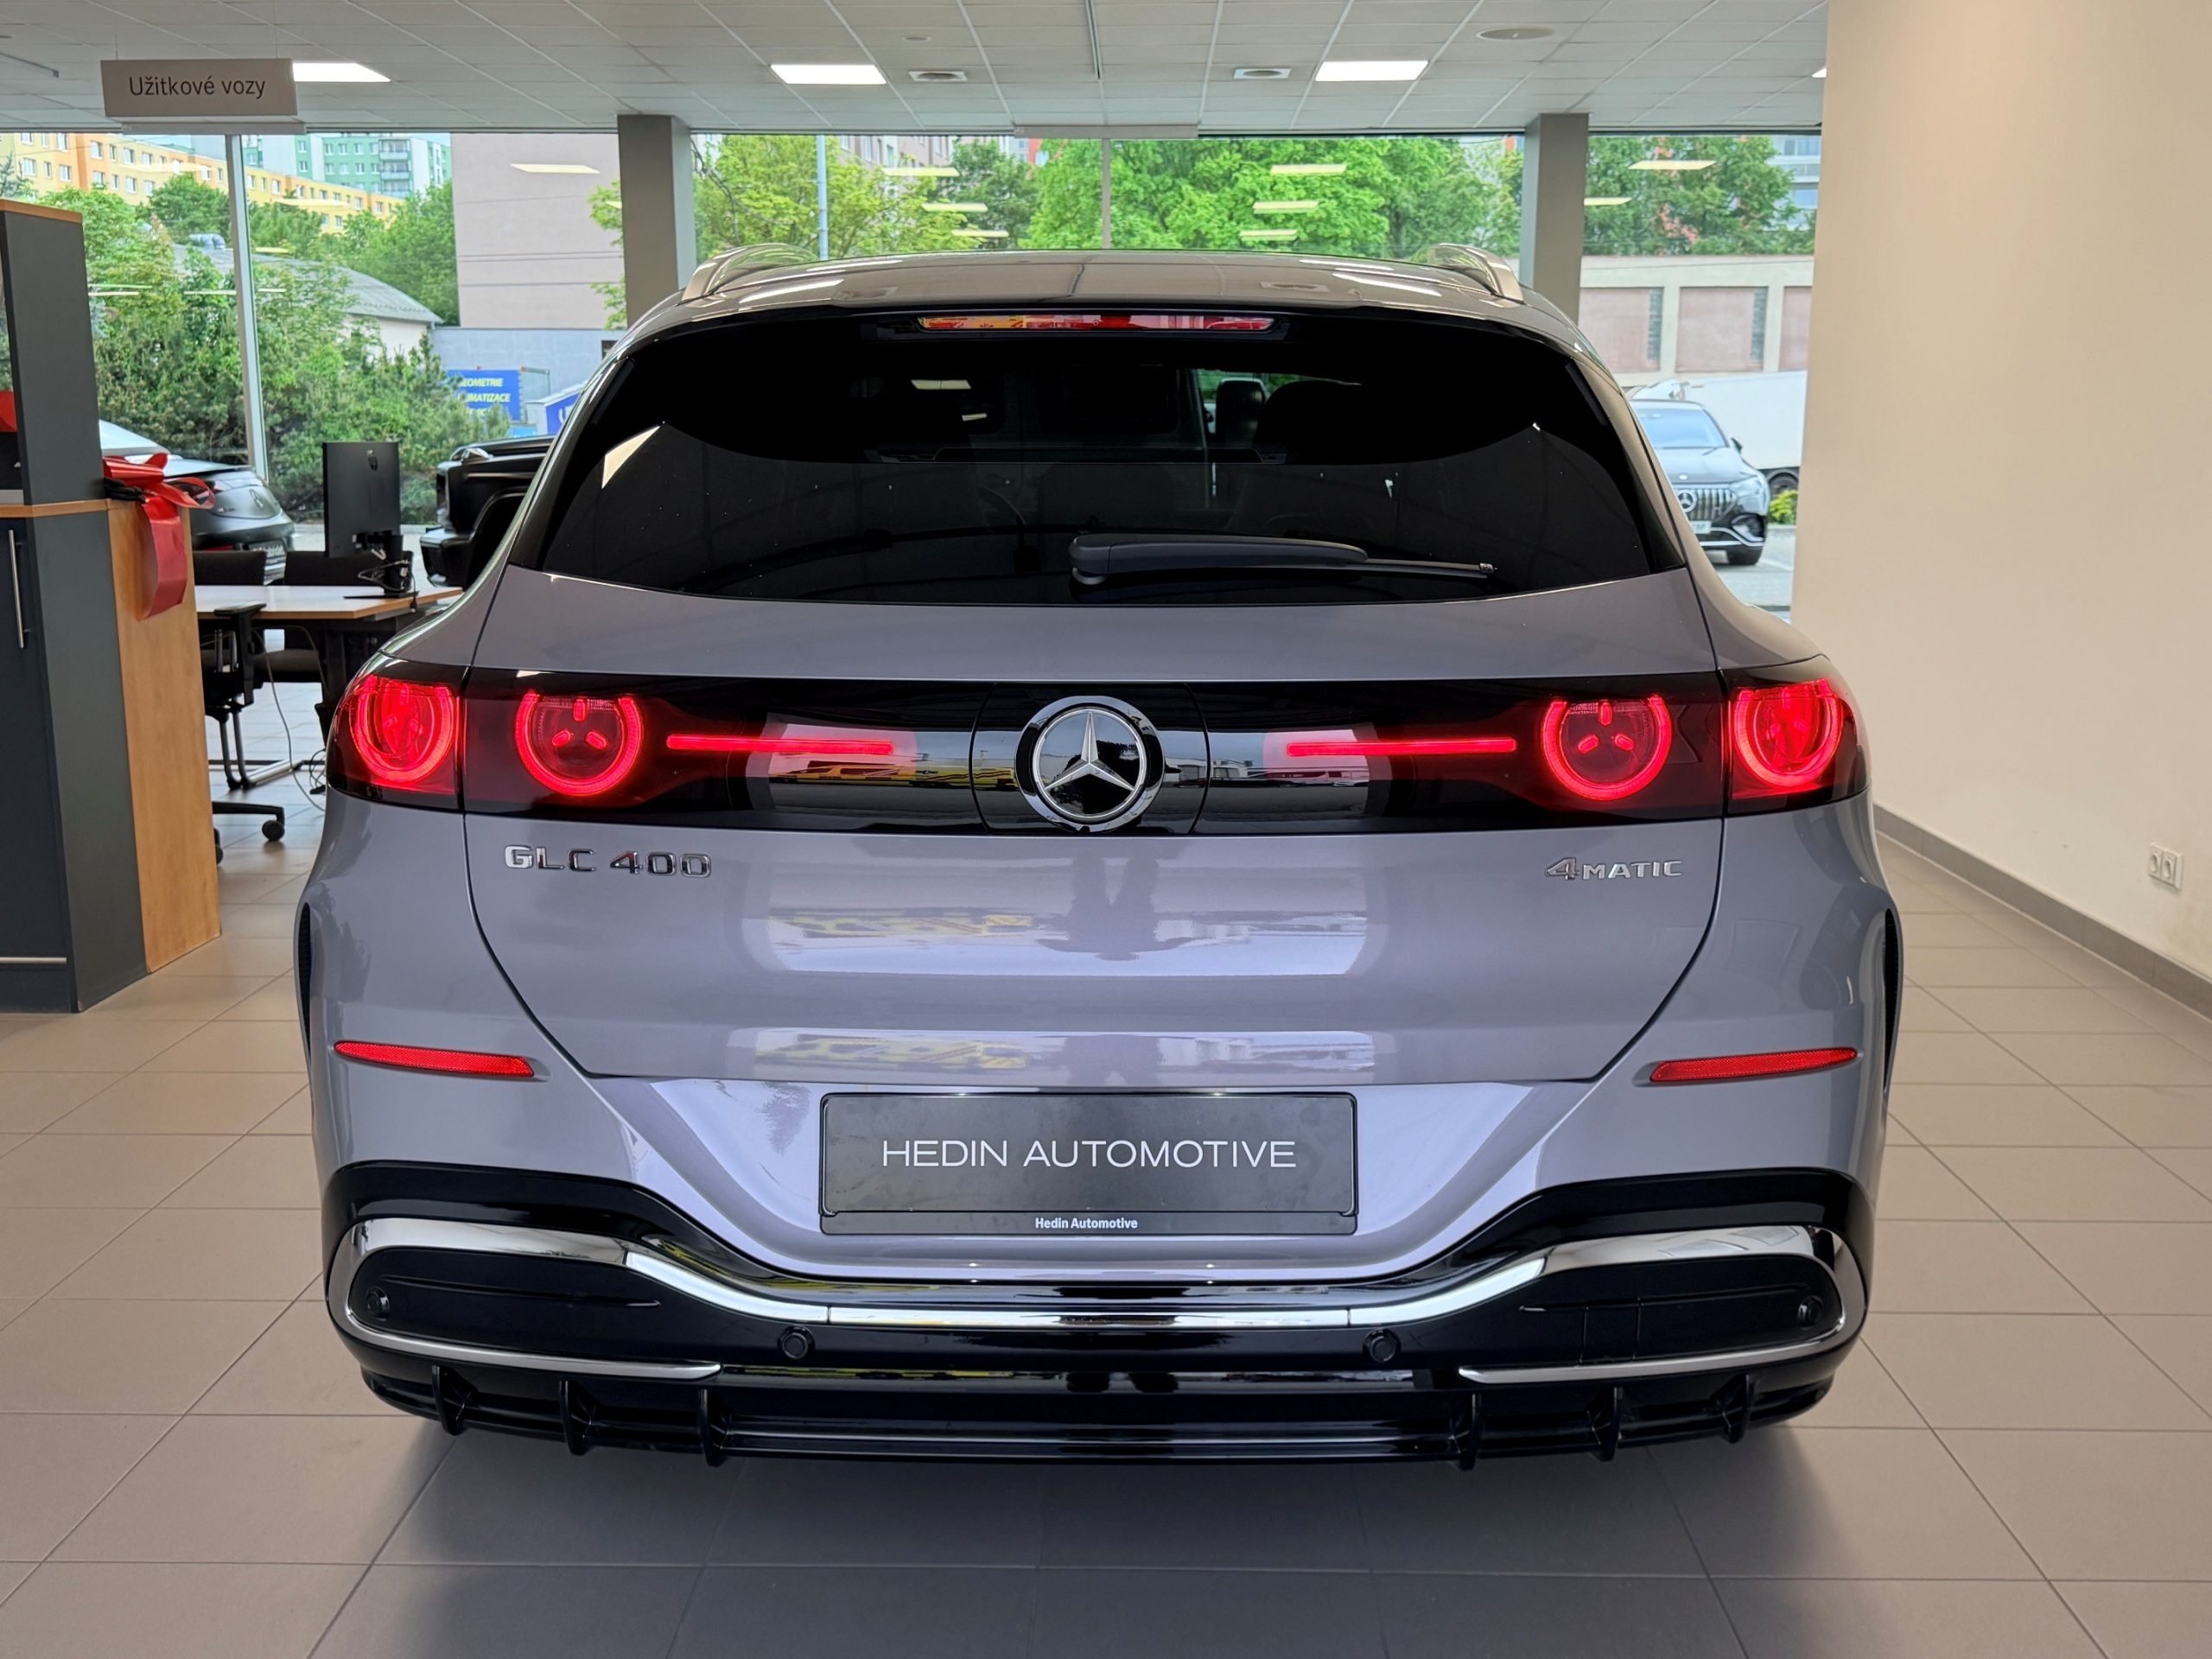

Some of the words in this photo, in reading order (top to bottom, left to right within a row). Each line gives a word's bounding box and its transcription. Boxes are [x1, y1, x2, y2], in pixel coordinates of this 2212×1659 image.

[129, 75, 215, 96] Užitkové
[221, 79, 265, 99] vozy
[457, 392, 511, 403] IMATIZACE
[504, 844, 596, 872] GLC
[609, 849, 713, 879] 400
[1545, 857, 1683, 880] 4MATIC
[881, 1140, 1008, 1168] HEDIN
[1023, 1140, 1296, 1168] AUTOMOTIVE
[1034, 1217, 1069, 1229] Hedin
[1071, 1217, 1138, 1229] Automotive
